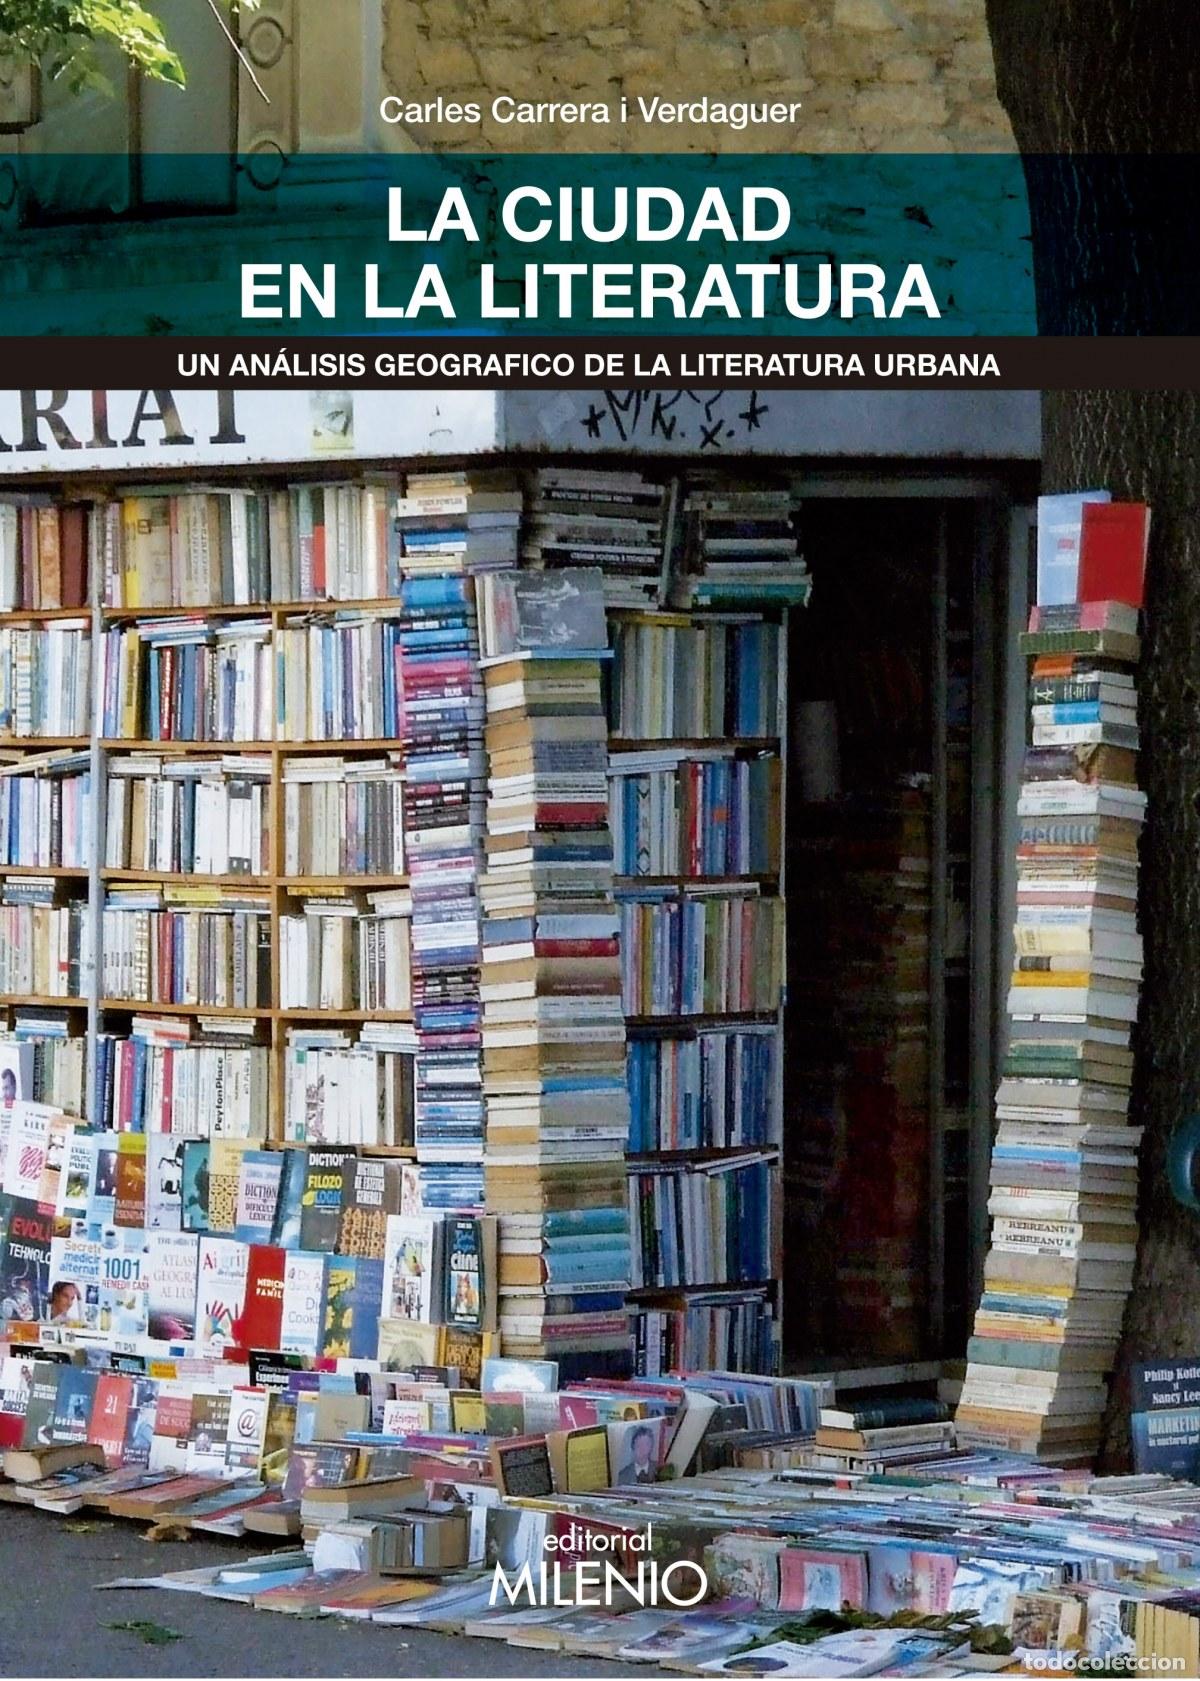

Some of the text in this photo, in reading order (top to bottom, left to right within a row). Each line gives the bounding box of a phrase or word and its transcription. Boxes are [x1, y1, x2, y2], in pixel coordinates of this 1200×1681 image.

[1009, 1220, 1067, 1233] REBREANU
[1005, 1234, 1064, 1246] REBREANU
[104, 1258, 141, 1281] 1001
[1144, 1370, 1174, 1382] Philip
[1152, 1390, 1200, 1405] Nancy Lee
